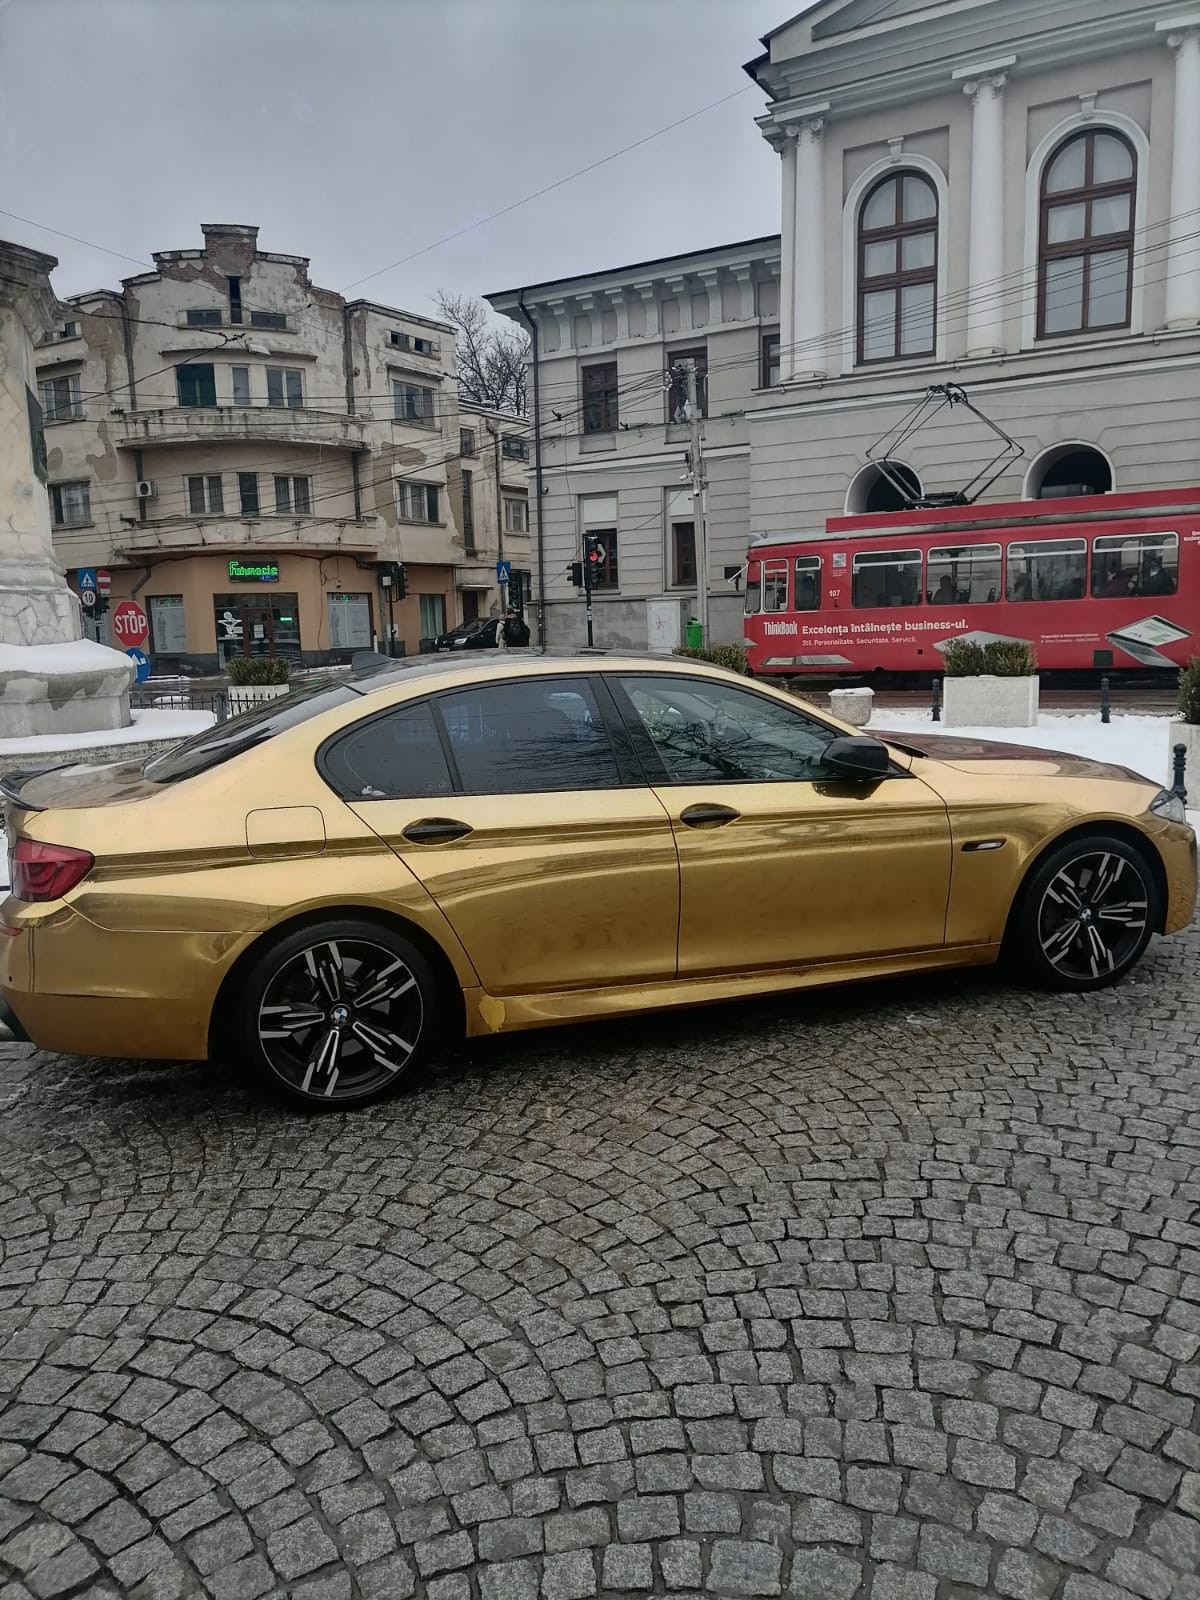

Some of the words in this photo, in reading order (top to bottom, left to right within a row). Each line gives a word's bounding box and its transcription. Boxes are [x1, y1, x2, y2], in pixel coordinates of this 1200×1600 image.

[229, 561, 278, 576] Farmacie
[84, 593, 93, 604] 10
[115, 615, 147, 634] STOP
[763, 621, 798, 635] ThinkBook
[904, 619, 969, 631] business-ul.
